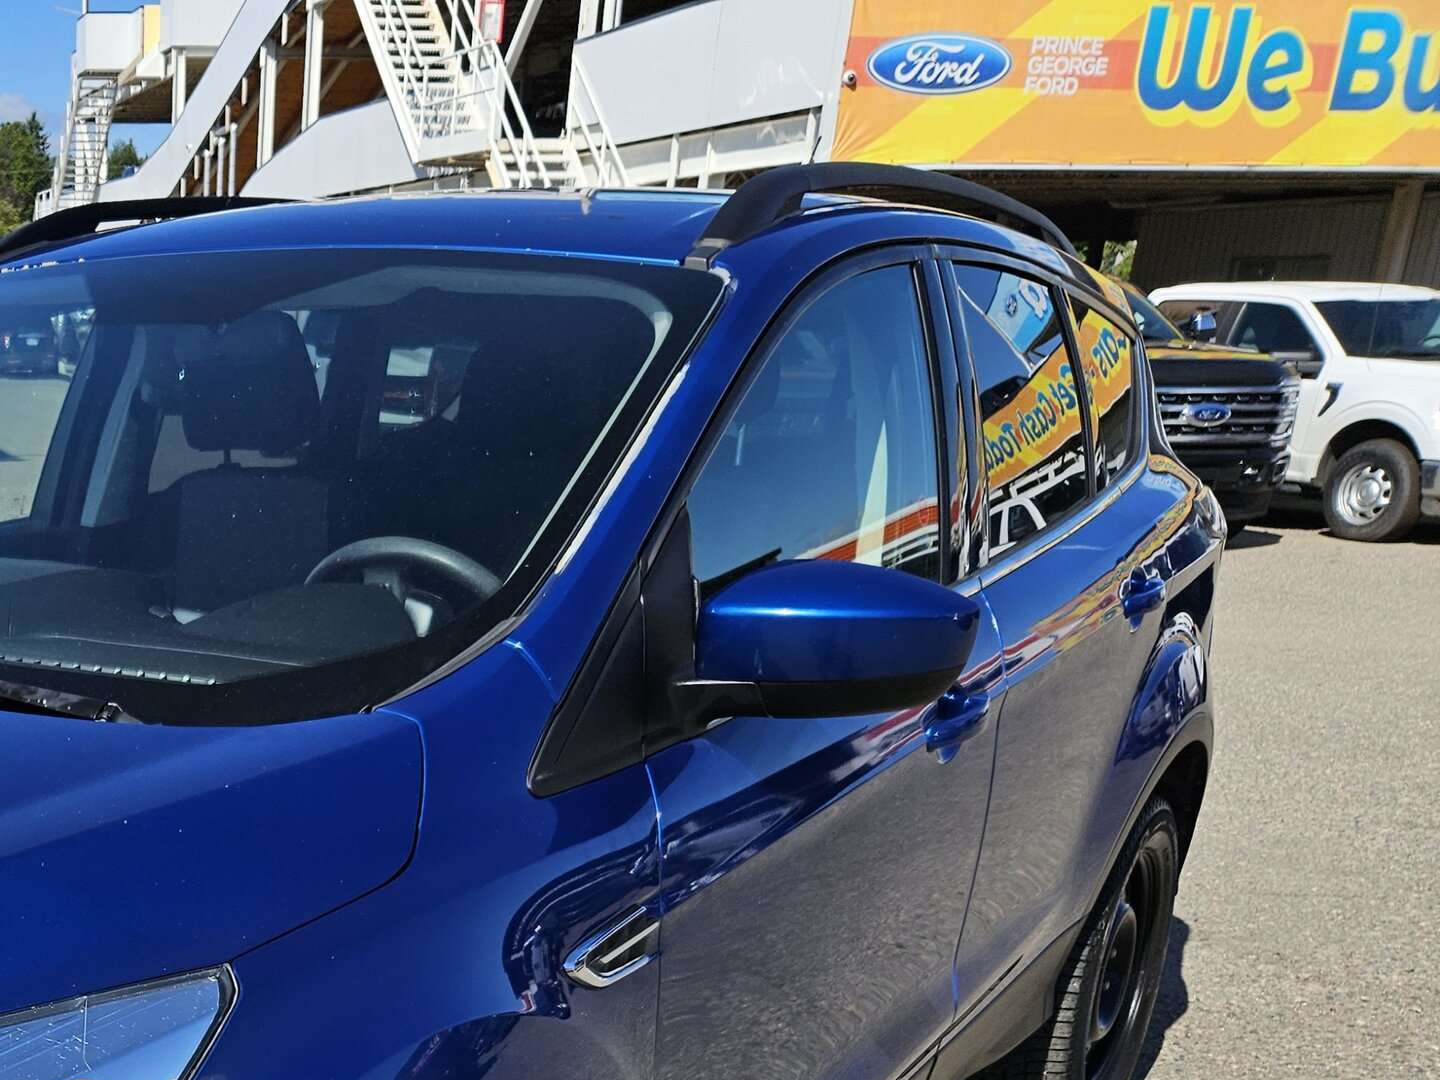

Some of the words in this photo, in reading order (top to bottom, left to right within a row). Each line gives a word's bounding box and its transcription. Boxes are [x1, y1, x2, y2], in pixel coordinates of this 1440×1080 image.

[1030, 35, 1104, 56] PRINCE
[893, 40, 985, 85] Ford
[1026, 56, 1109, 76] GEORGE
[1137, 5, 1305, 112] We
[1023, 76, 1079, 96] FORD
